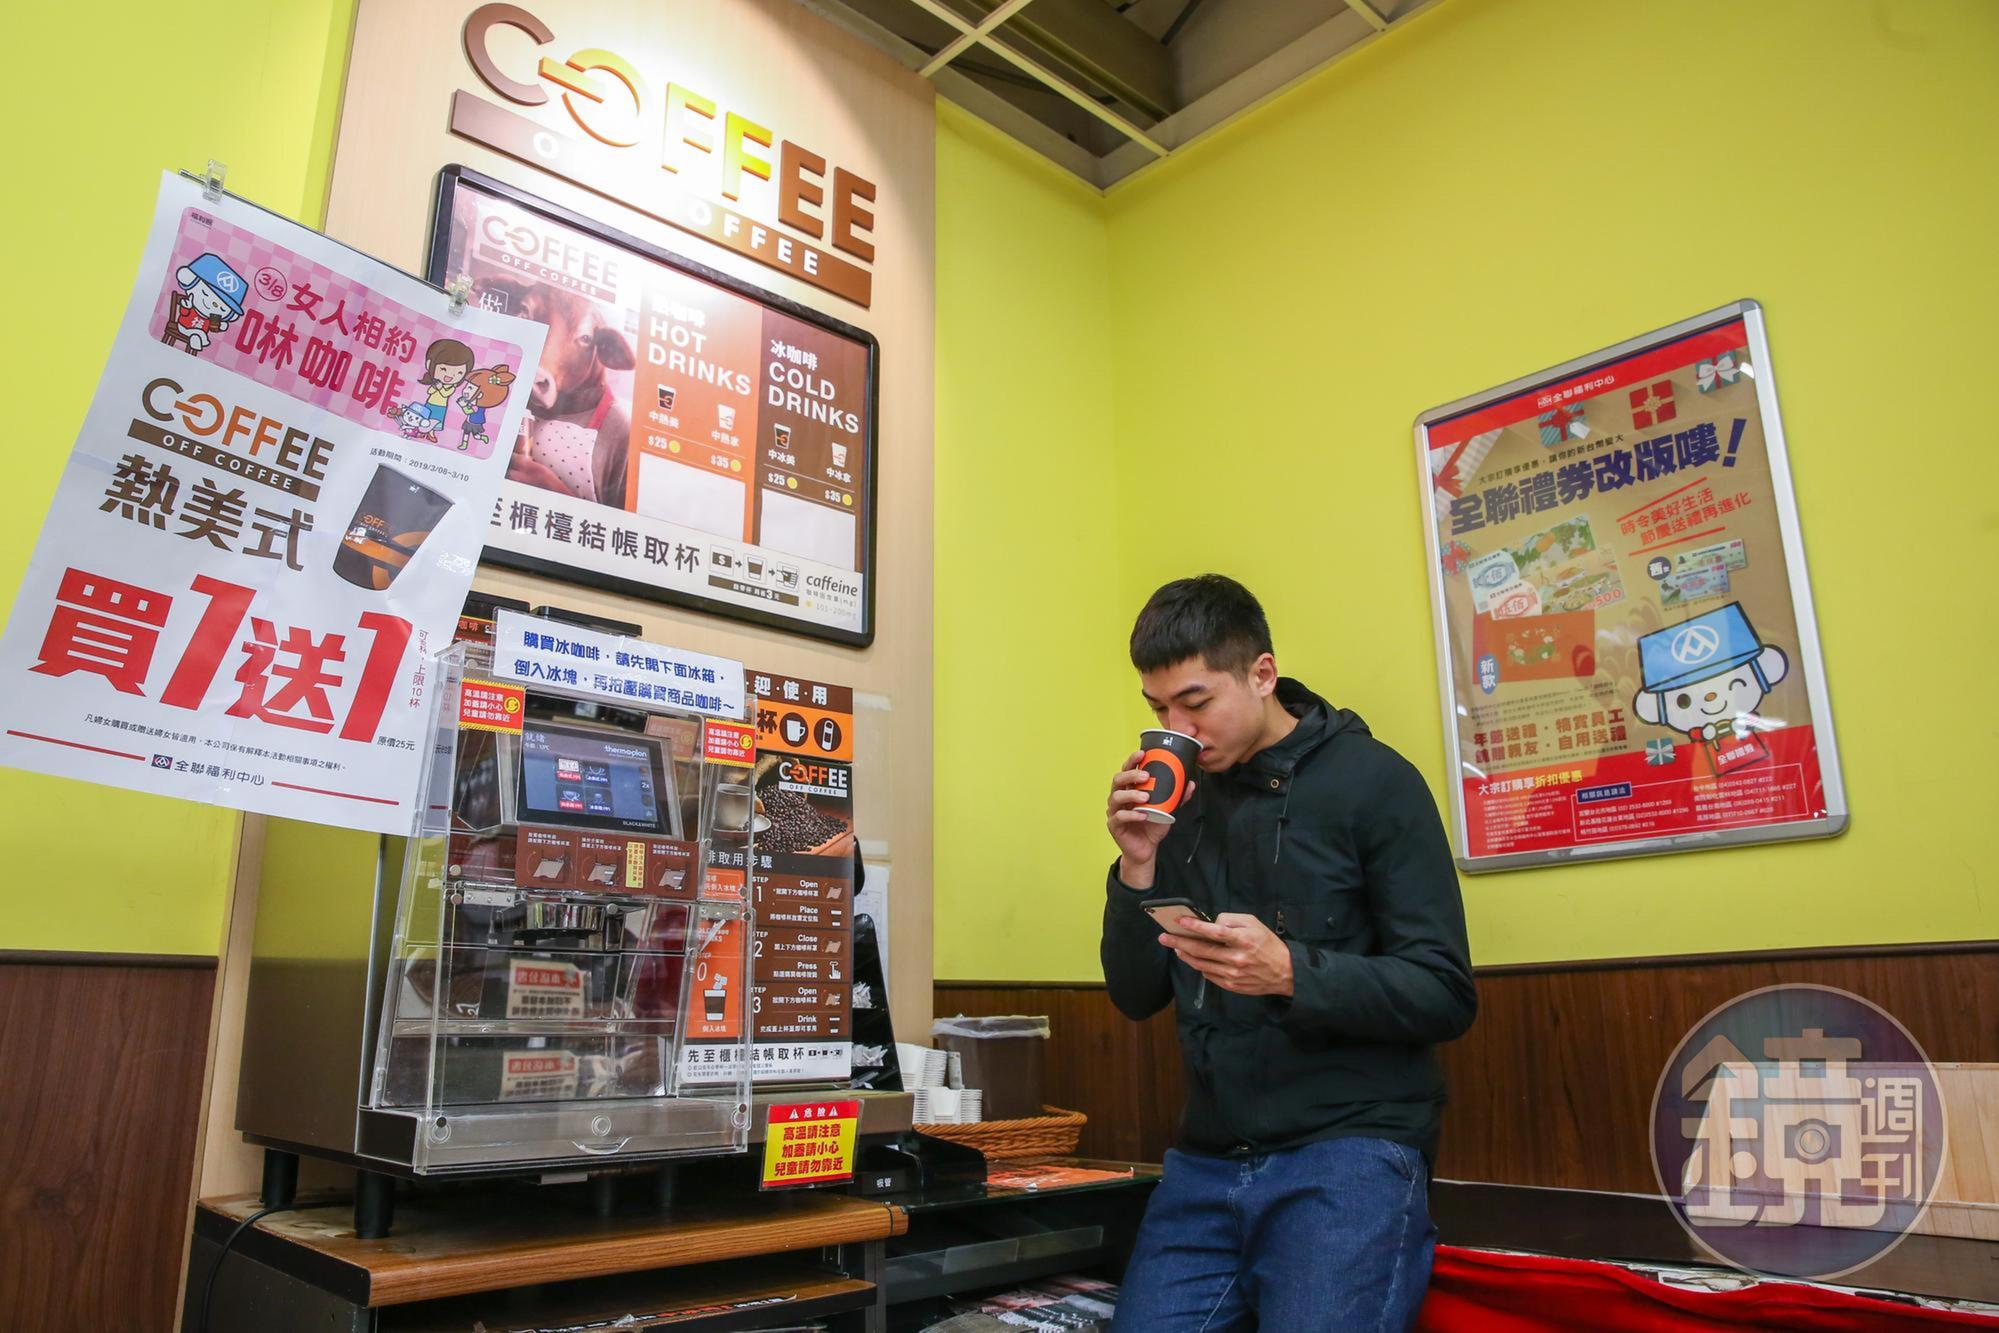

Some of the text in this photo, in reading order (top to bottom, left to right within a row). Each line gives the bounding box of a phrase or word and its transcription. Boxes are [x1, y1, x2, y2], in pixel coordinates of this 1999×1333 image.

[463, 2, 876, 263] COFFEE
[482, 215, 618, 289] COFFEE
[502, 254, 597, 295] OFF COFFEE
[259, 273, 284, 297] 3/8
[286, 283, 417, 364] 女人相約
[650, 316, 707, 353] HOT
[235, 309, 405, 415] 啉咖啡
[770, 339, 818, 371] 冰咖啡
[648, 343, 751, 395] DRINKS
[769, 362, 836, 400] COLD
[768, 385, 860, 434] DRINKS
[142, 377, 335, 481] COFFEE
[648, 435, 667, 450] $25
[162, 434, 293, 490] OFF COFFEE
[710, 455, 729, 469] $35
[768, 472, 785, 486] $25
[825, 490, 841, 503] $35
[98, 453, 314, 571] 熱美式
[1620, 488, 1713, 537] 時令美好生活
[1641, 492, 1752, 547] 節慶送禮再進化
[806, 575, 858, 596] caffeine
[27, 567, 413, 744] 買1送1
[377, 735, 415, 752] 原價25元
[174, 760, 265, 786] 全聯福利中心
[779, 762, 848, 788] COFFEE
[807, 786, 837, 796] COFFEE
[756, 886, 763, 903] 1
[800, 880, 818, 889] Open
[800, 906, 818, 914] Place
[798, 934, 817, 943] Close
[754, 941, 763, 958] 2
[697, 962, 707, 982] 0
[797, 962, 817, 970] Press
[798, 987, 817, 996] Open
[753, 996, 762, 1014] 3
[797, 1014, 817, 1023] Drink
[804, 1107, 826, 1119] 危險
[783, 1123, 842, 1141] 高溫請注意
[782, 1141, 839, 1158] 加蓋請小心
[774, 1157, 844, 1177] 兒童請勿靠近
